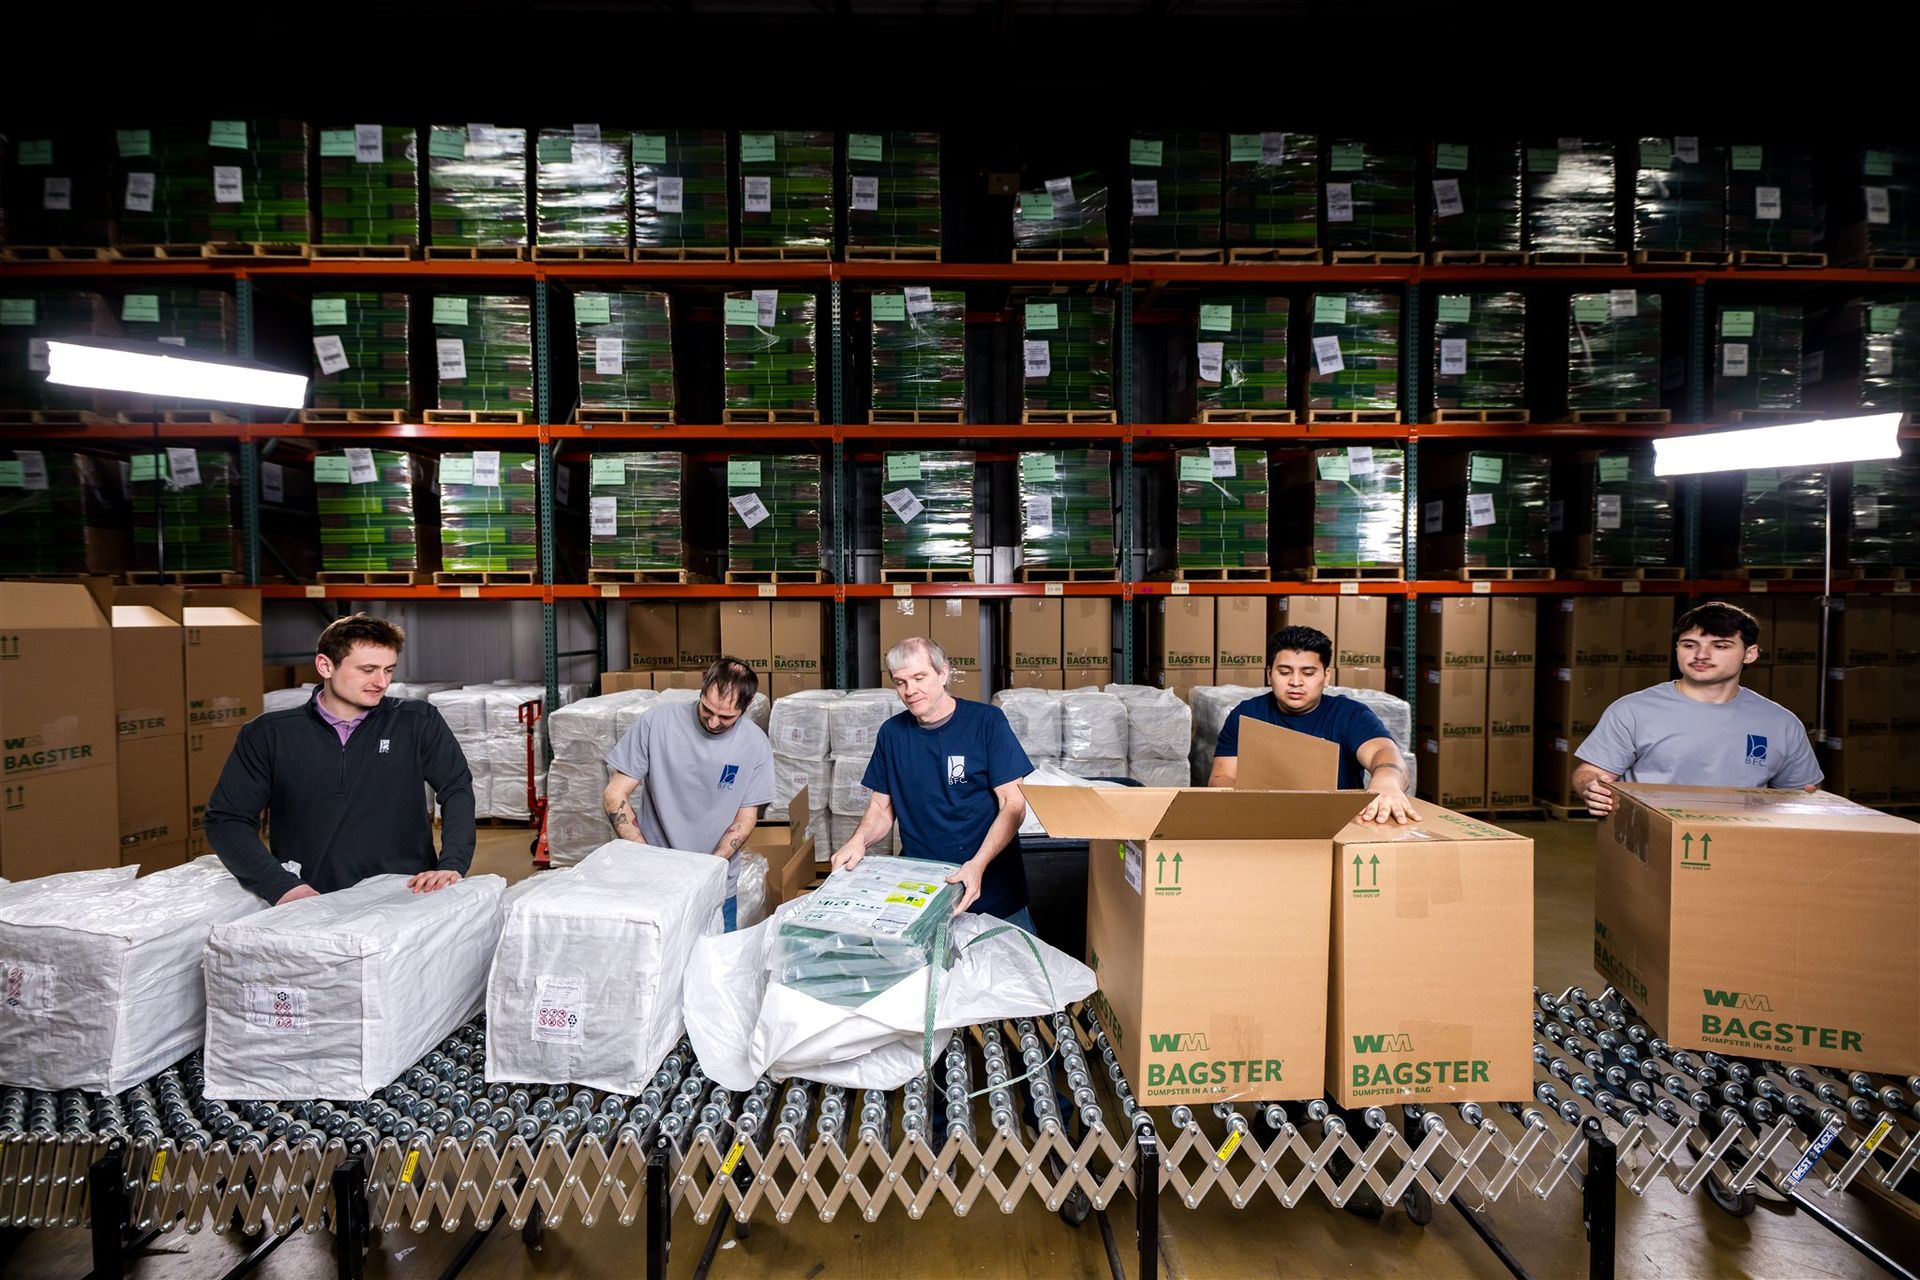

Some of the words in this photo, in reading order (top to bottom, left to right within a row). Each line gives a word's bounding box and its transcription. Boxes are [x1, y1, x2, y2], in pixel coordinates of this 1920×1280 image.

[633, 656, 674, 665] BAGSTER
[744, 659, 768, 668] STER
[1015, 656, 1058, 665] BAGSTER
[1066, 656, 1109, 665] BAGSTER
[1168, 655, 1211, 664] BAGSTER
[1220, 655, 1263, 664] BAGSTER
[1340, 655, 1381, 664] BAGSTER
[1444, 655, 1485, 664] BAGSTER
[1494, 654, 1532, 663] BAGSTER
[774, 660, 817, 668] BAGSTER
[190, 707, 247, 722] BAGSTER
[118, 717, 166, 733] GSTER
[1443, 726, 1482, 735] BAGSTER
[4, 744, 93, 770] BAGSTER
[1745, 757, 1767, 767] BFC
[948, 777, 968, 786] BFC
[120, 826, 169, 846] GSTER
[1702, 988, 1773, 1012] WM
[1702, 1014, 1863, 1052] BAGSTER
[1149, 1033, 1210, 1052] WM
[1352, 1034, 1414, 1053] WM
[1701, 1036, 1751, 1048] DUMPSTER
[1147, 1059, 1283, 1086] BAGSTER
[1352, 1060, 1490, 1087] BAGSTER
[1147, 1087, 1190, 1096] DUMPSTER
[1352, 1087, 1395, 1096] DUMPSTER
[1414, 1086, 1431, 1094] BAG
[1791, 1156, 1814, 1180] BEST
[1812, 1130, 1834, 1154] FLEX
